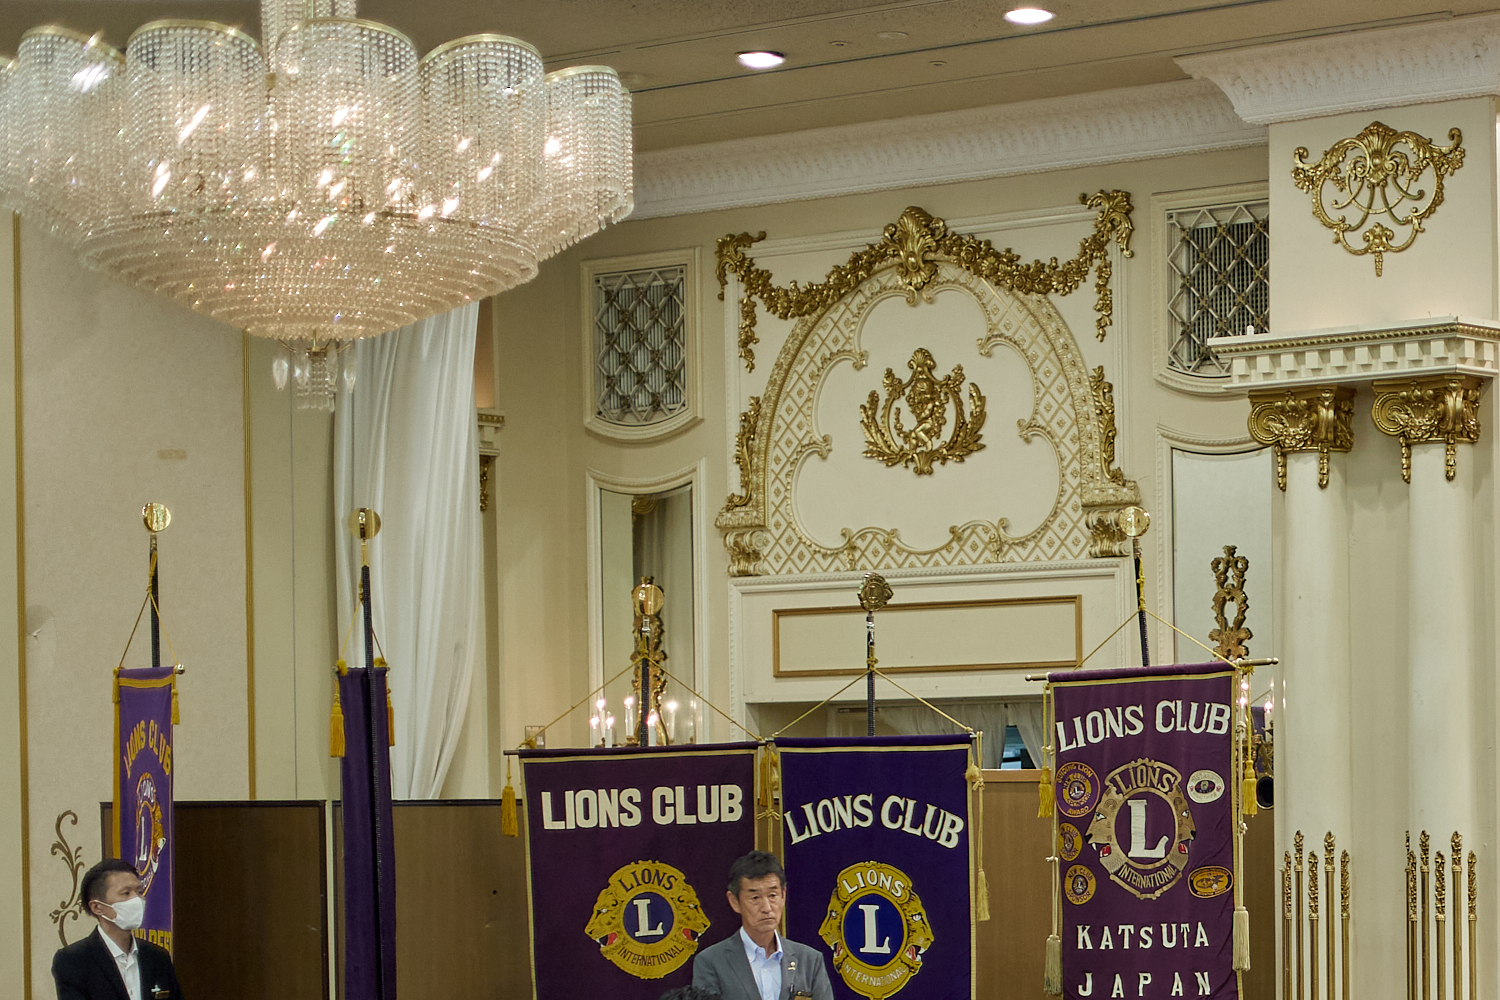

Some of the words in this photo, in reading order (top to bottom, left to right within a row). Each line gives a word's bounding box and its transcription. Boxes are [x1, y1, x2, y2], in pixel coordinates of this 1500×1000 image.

[1055, 704, 1144, 753] LIONS
[1155, 700, 1231, 735] CLUB
[1114, 765, 1176, 795] LIONS
[541, 788, 642, 830] LIONS
[651, 784, 743, 825] CLUB
[783, 793, 874, 846] LIONS
[880, 794, 965, 849] CLUB
[1127, 799, 1169, 859] L
[618, 868, 678, 892] LIONS
[842, 869, 905, 898] LIONS
[1118, 864, 1178, 889] INTERNATIONAL
[633, 898, 664, 937] L
[858, 904, 890, 954] L
[1076, 921, 1209, 950] KATSUTA
[617, 943, 685, 967] INTERNATIONAL
[842, 961, 909, 987] INTERNATIONAL
[1077, 971, 1211, 999] JAPAN
